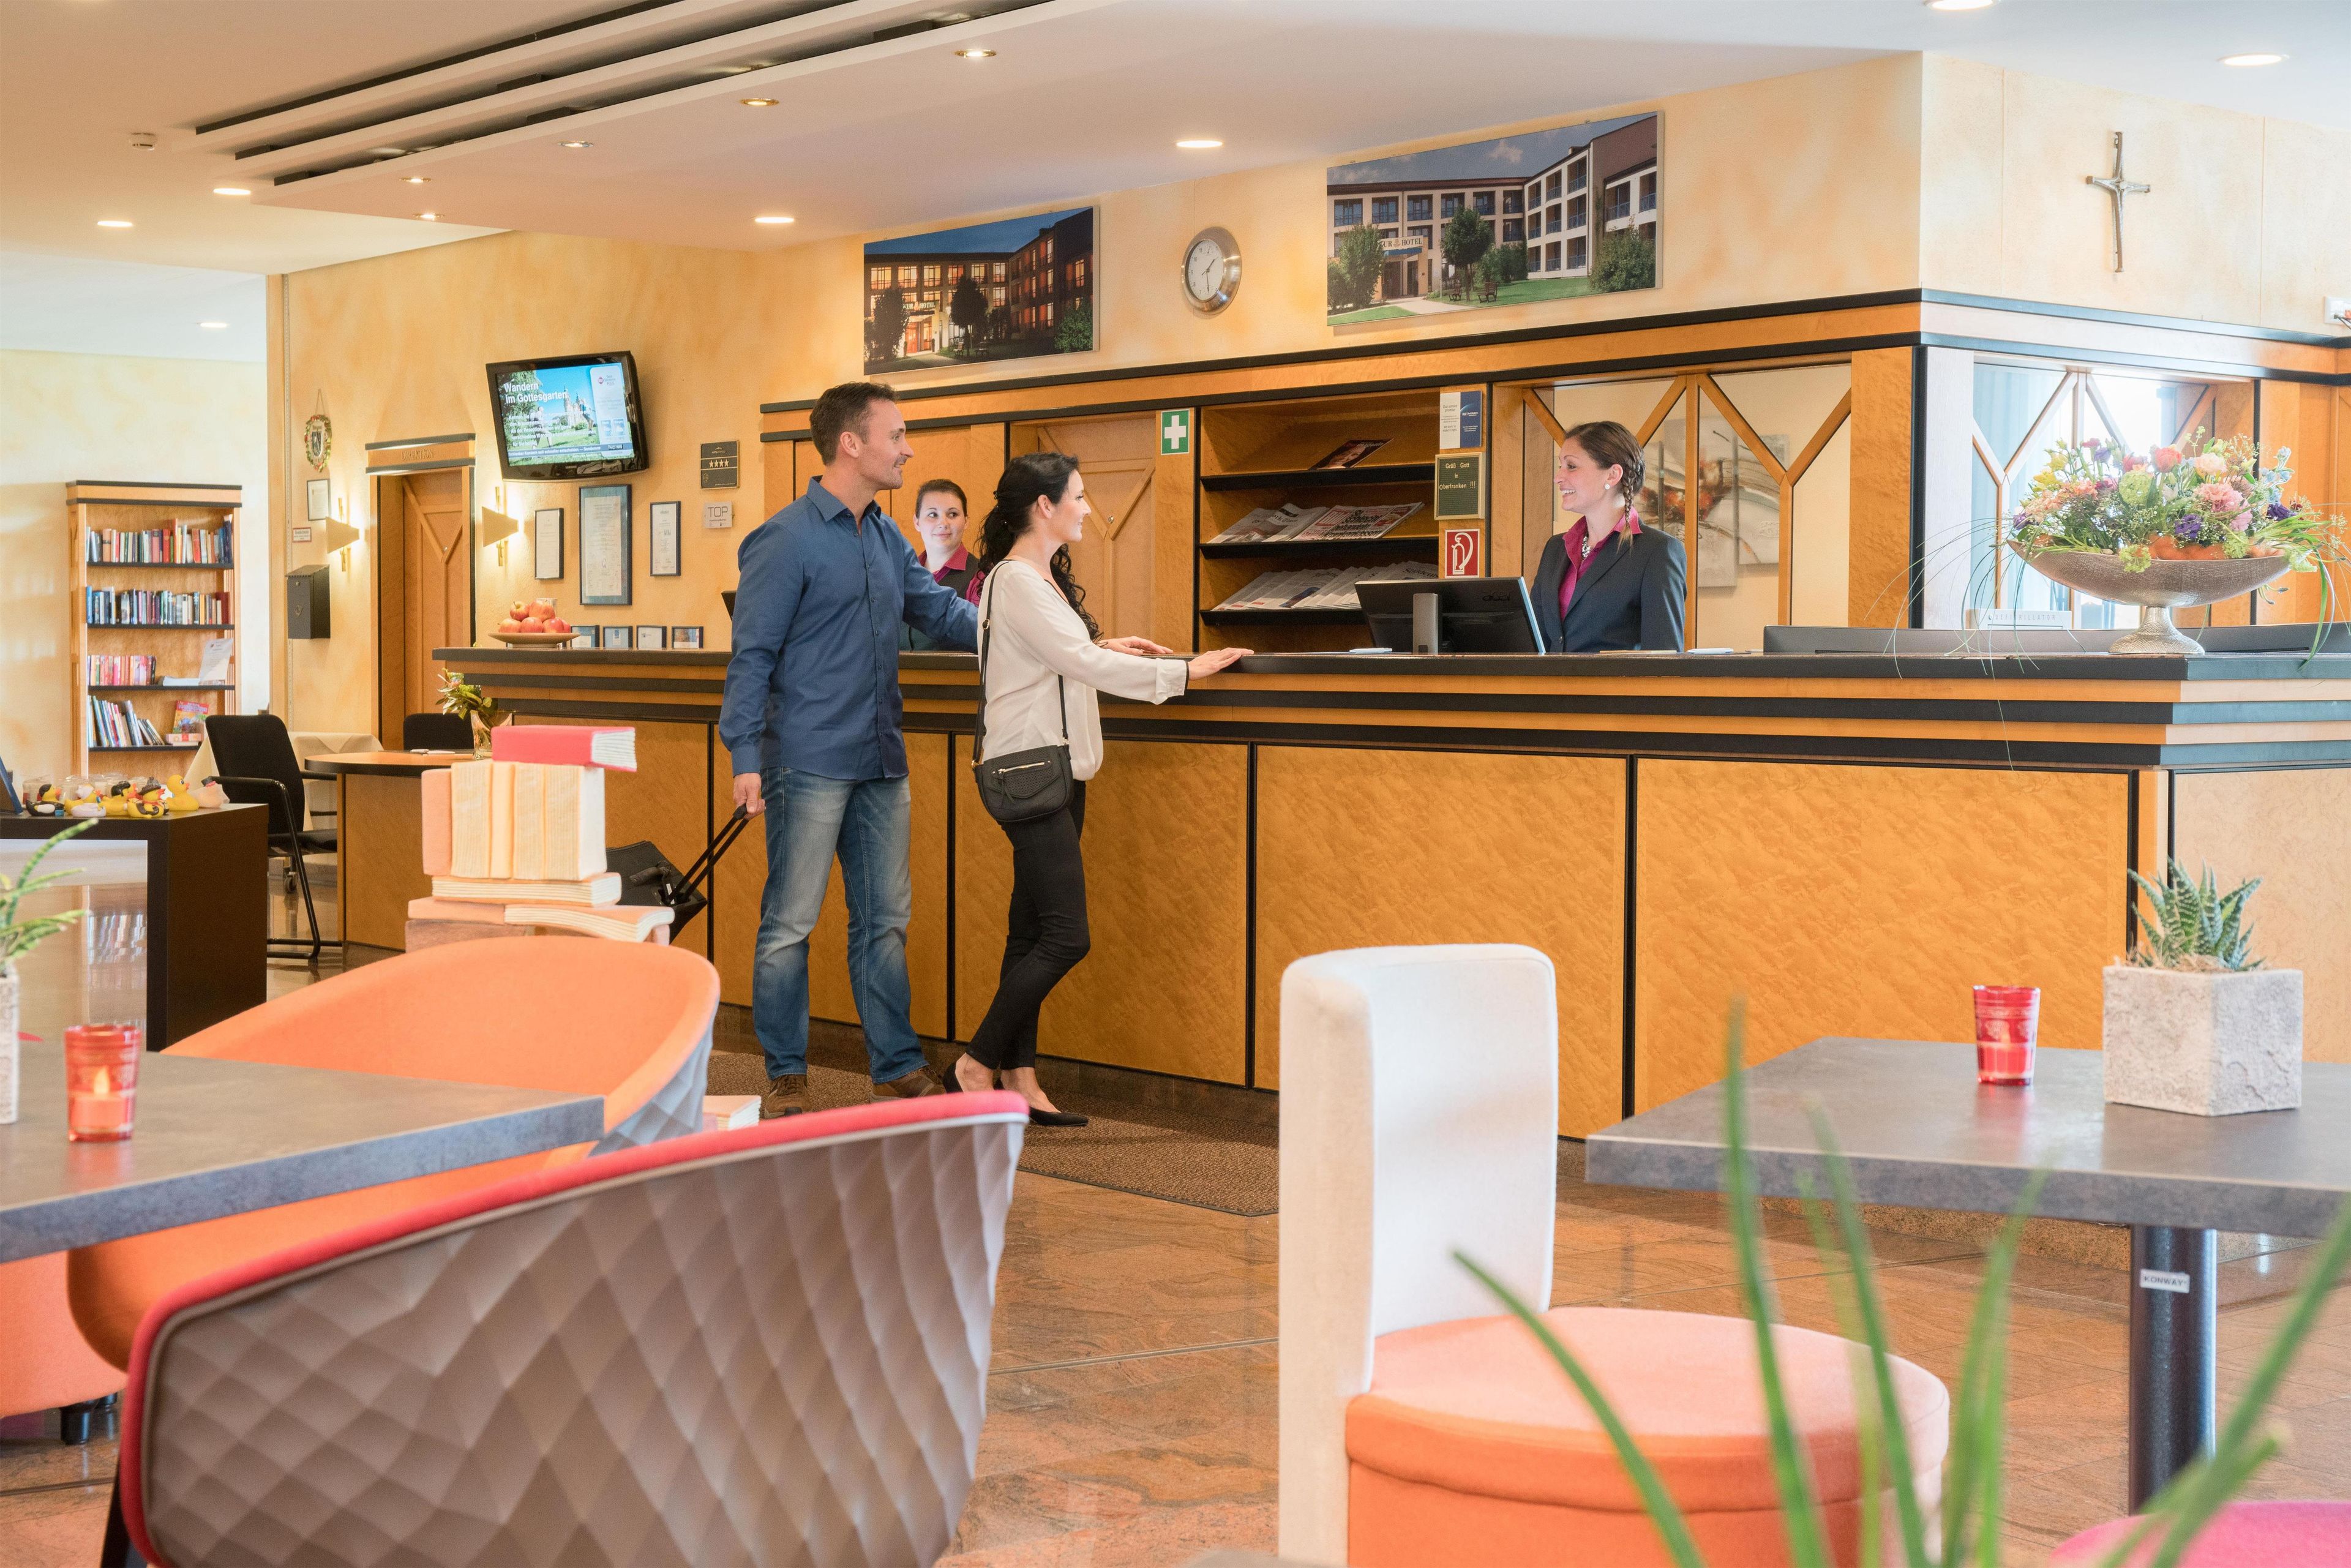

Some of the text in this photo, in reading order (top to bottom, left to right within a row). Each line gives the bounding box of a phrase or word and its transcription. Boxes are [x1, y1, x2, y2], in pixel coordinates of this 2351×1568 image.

[503, 382, 539, 392] Wandern
[505, 392, 567, 404] im Gottesgarten
[402, 448, 435, 461] DIREKTION
[708, 506, 728, 517] TOP
[2145, 1276, 2183, 1286] KONWAY
